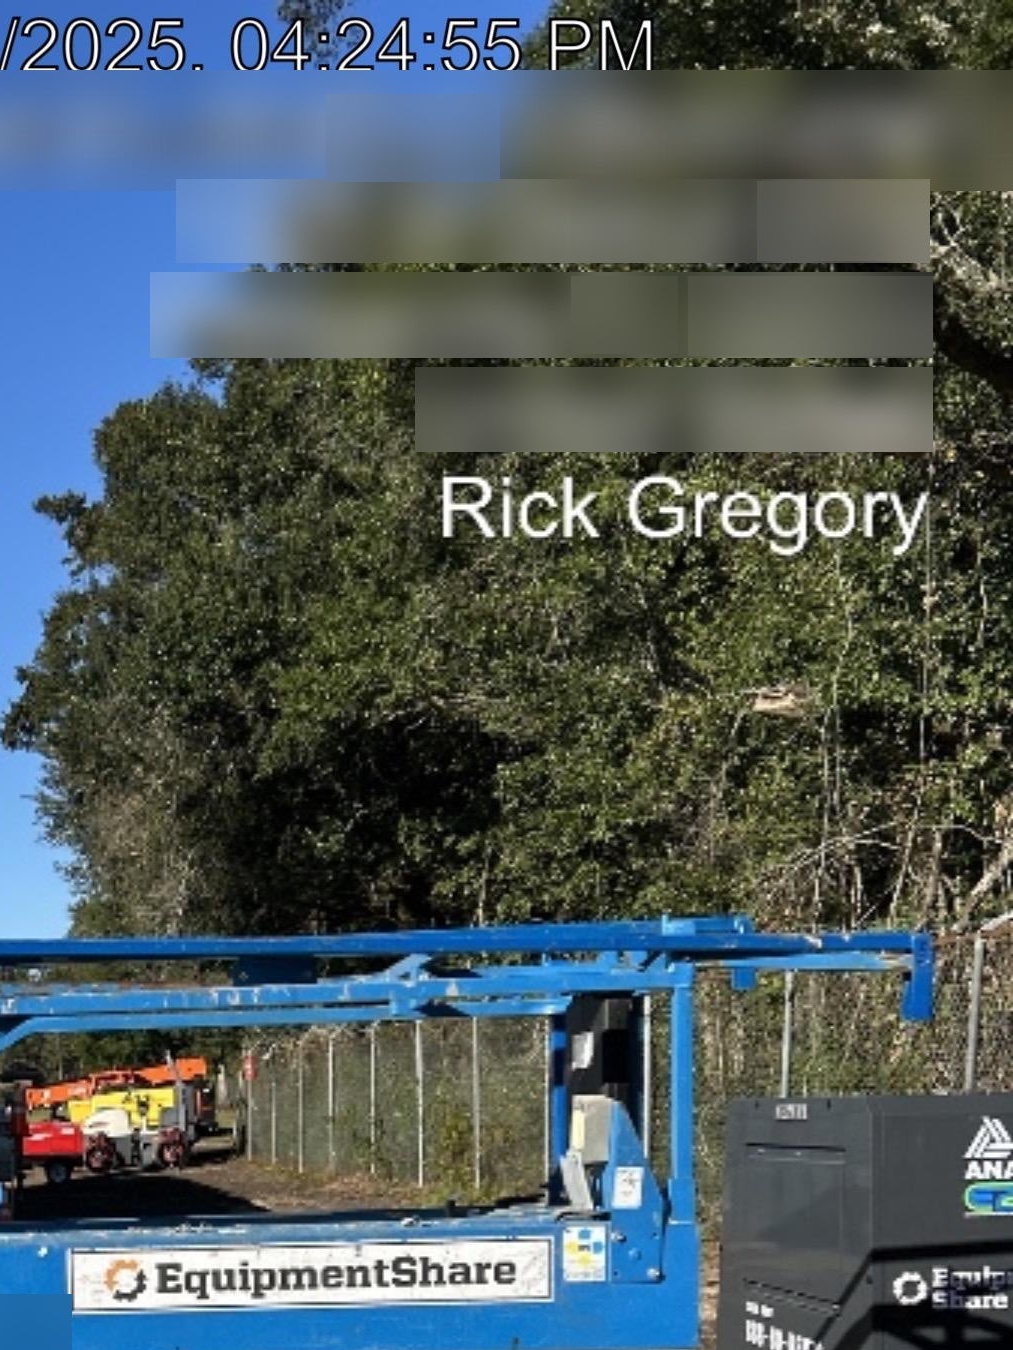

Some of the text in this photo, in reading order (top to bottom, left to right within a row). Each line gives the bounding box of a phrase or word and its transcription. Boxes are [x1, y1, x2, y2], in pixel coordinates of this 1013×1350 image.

[155, 1256, 517, 1300] EquipmentShare
[932, 1266, 1013, 1290] Equip
[932, 1289, 1009, 1309] Share
